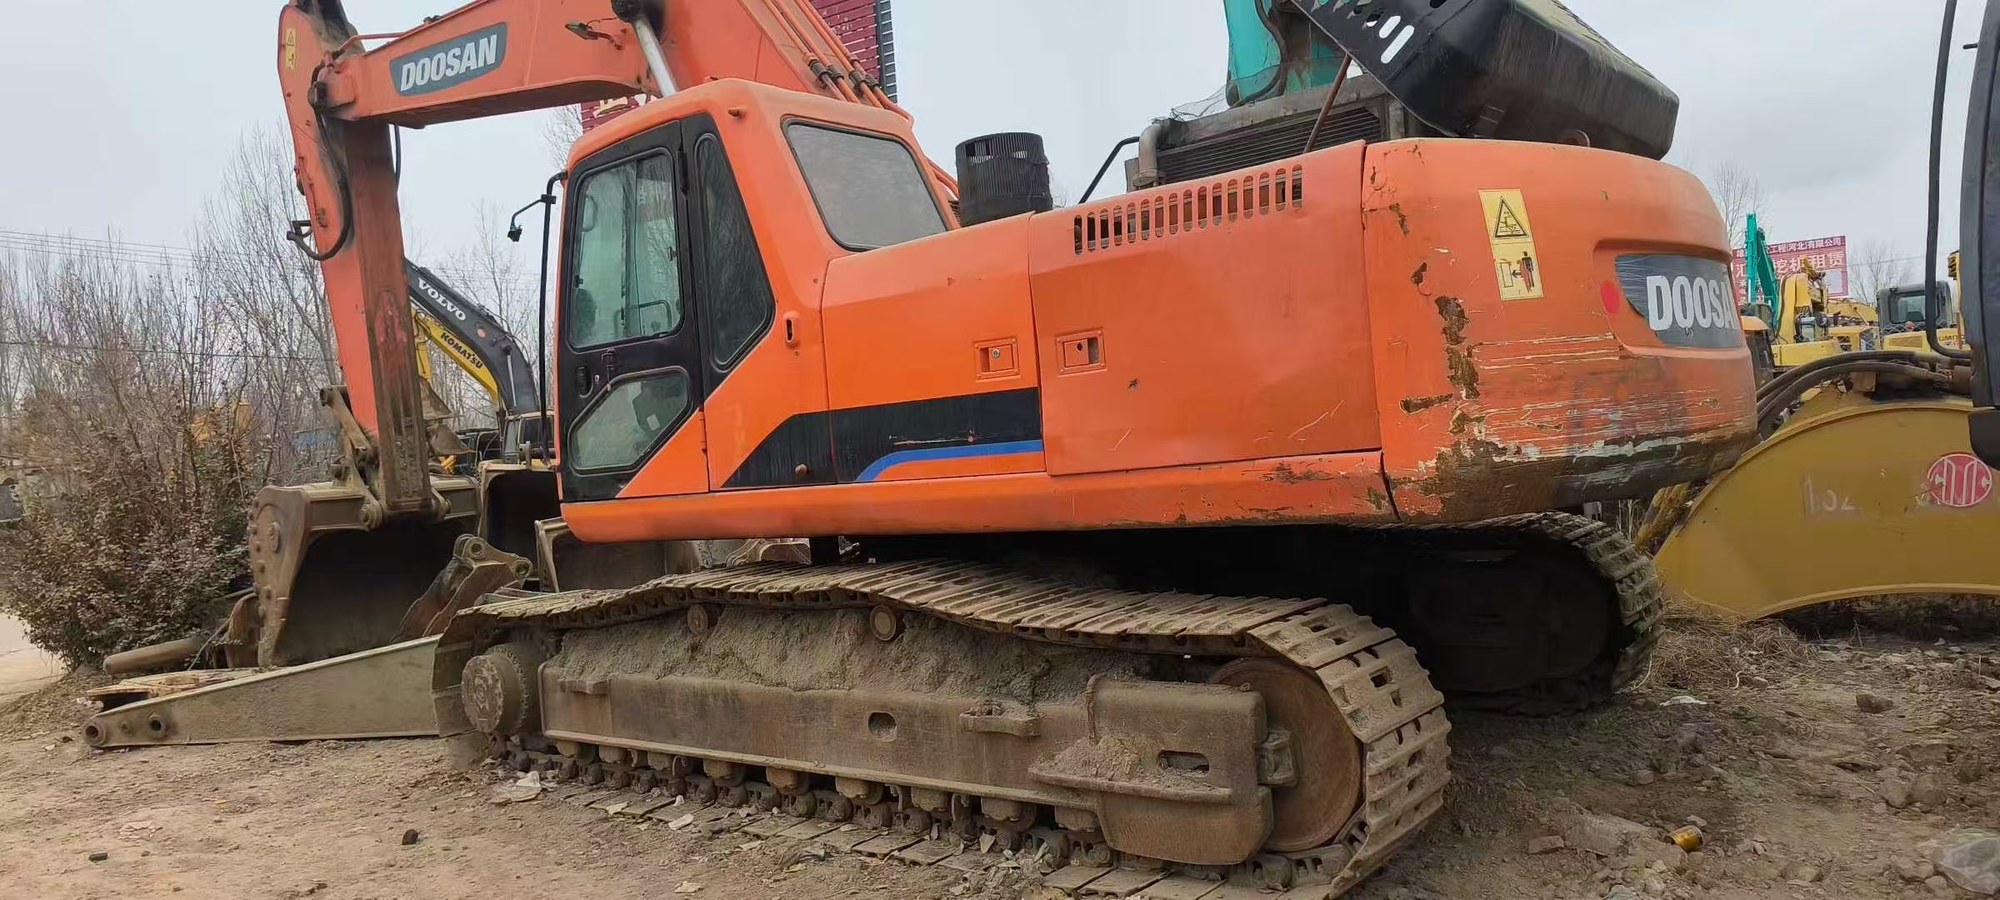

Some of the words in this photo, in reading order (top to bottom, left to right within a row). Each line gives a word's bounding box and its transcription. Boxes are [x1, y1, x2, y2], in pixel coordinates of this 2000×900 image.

[400, 34, 497, 92] DOOSAN
[417, 278, 467, 320] VOLVO
[440, 332, 484, 370] KOMATSU
